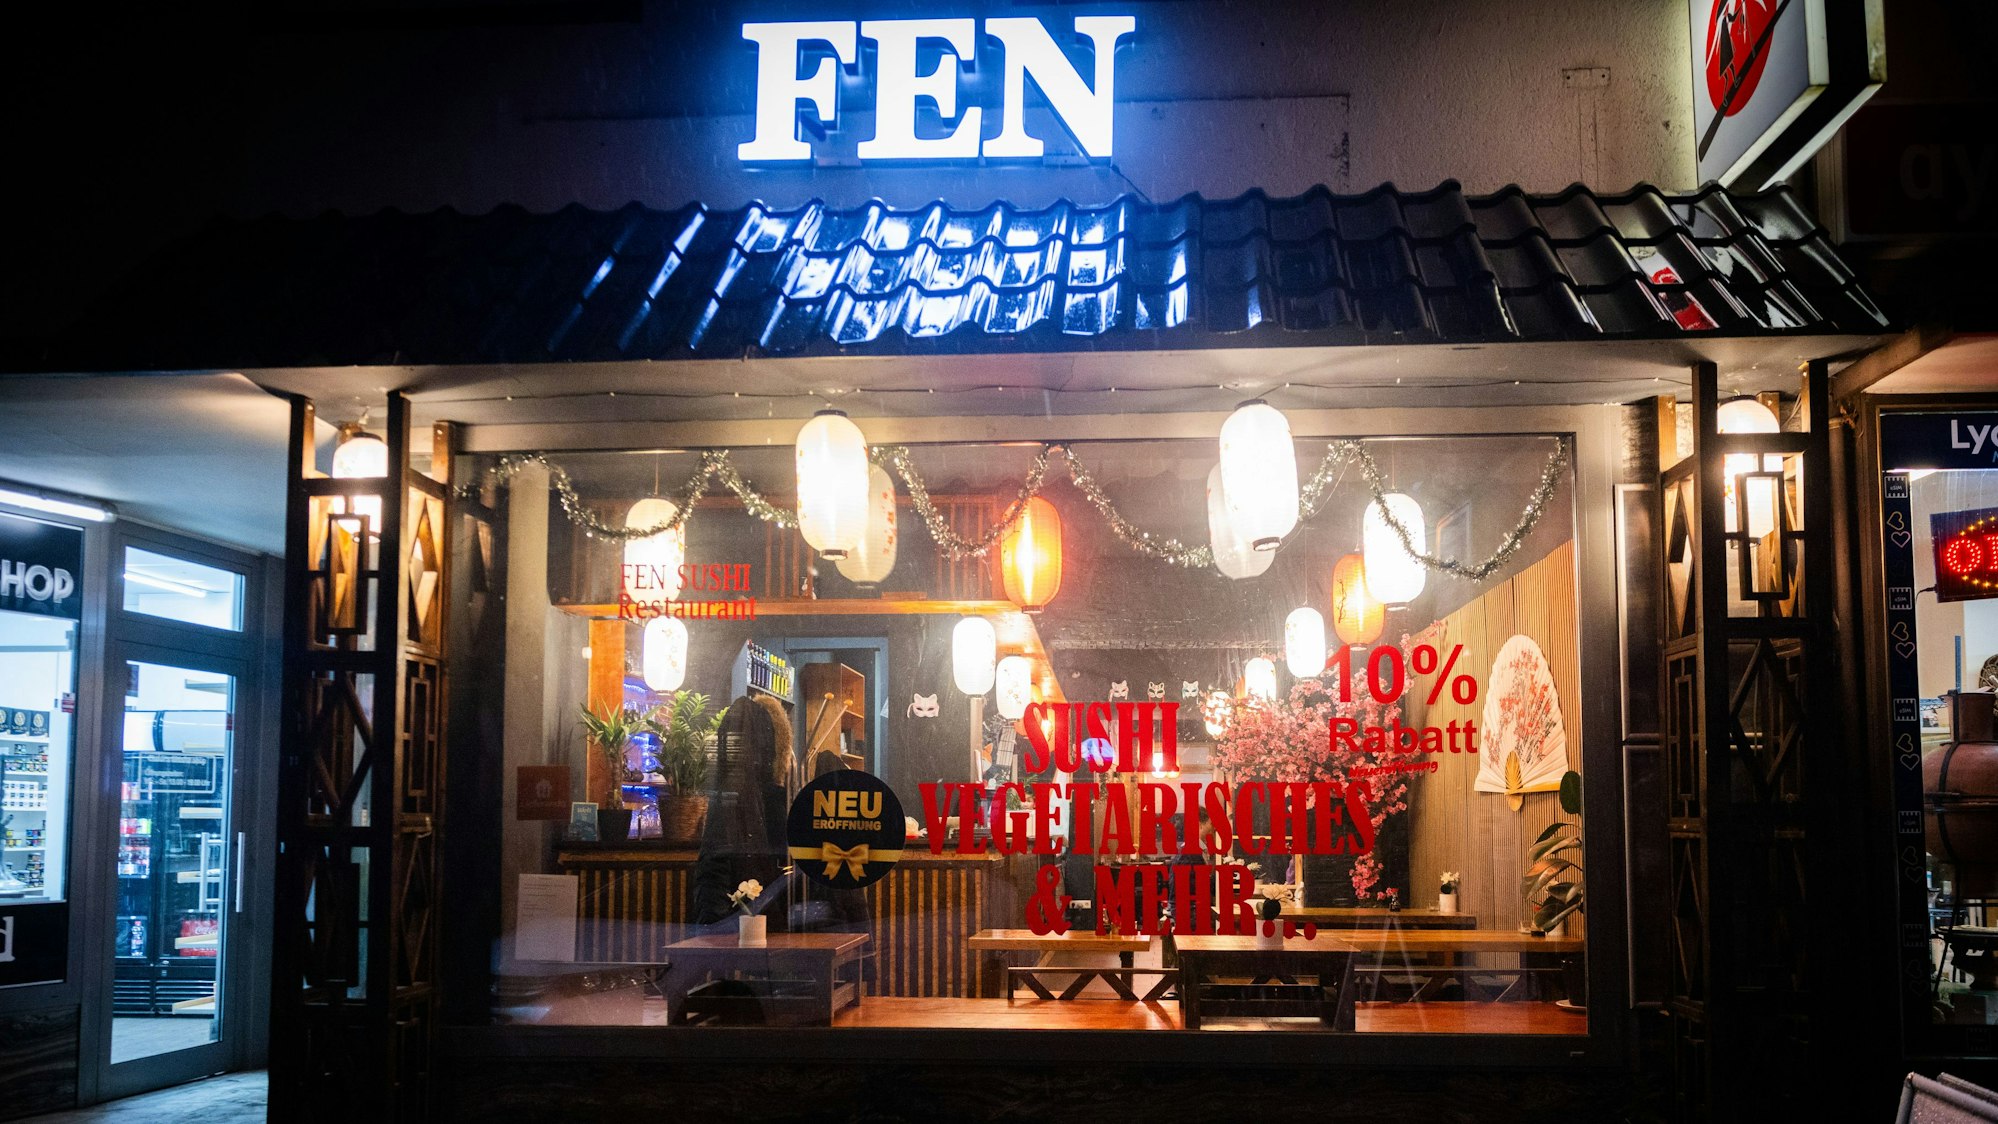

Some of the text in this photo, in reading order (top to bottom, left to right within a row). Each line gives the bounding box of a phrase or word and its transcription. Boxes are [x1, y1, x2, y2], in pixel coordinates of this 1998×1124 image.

[738, 15, 1136, 161] FEN
[620, 562, 752, 592] FEN SUSHI
[617, 592, 758, 621] Restaurant
[1325, 643, 1478, 706] 10%
[1022, 701, 1181, 775] SUSHI
[1328, 717, 1478, 754] Rabatt
[813, 790, 883, 819] NEU
[813, 818, 882, 831] ERÖFFNUNG
[918, 780, 1377, 857] VEGETARISCHES
[1025, 863, 1317, 942] & MEHR...
